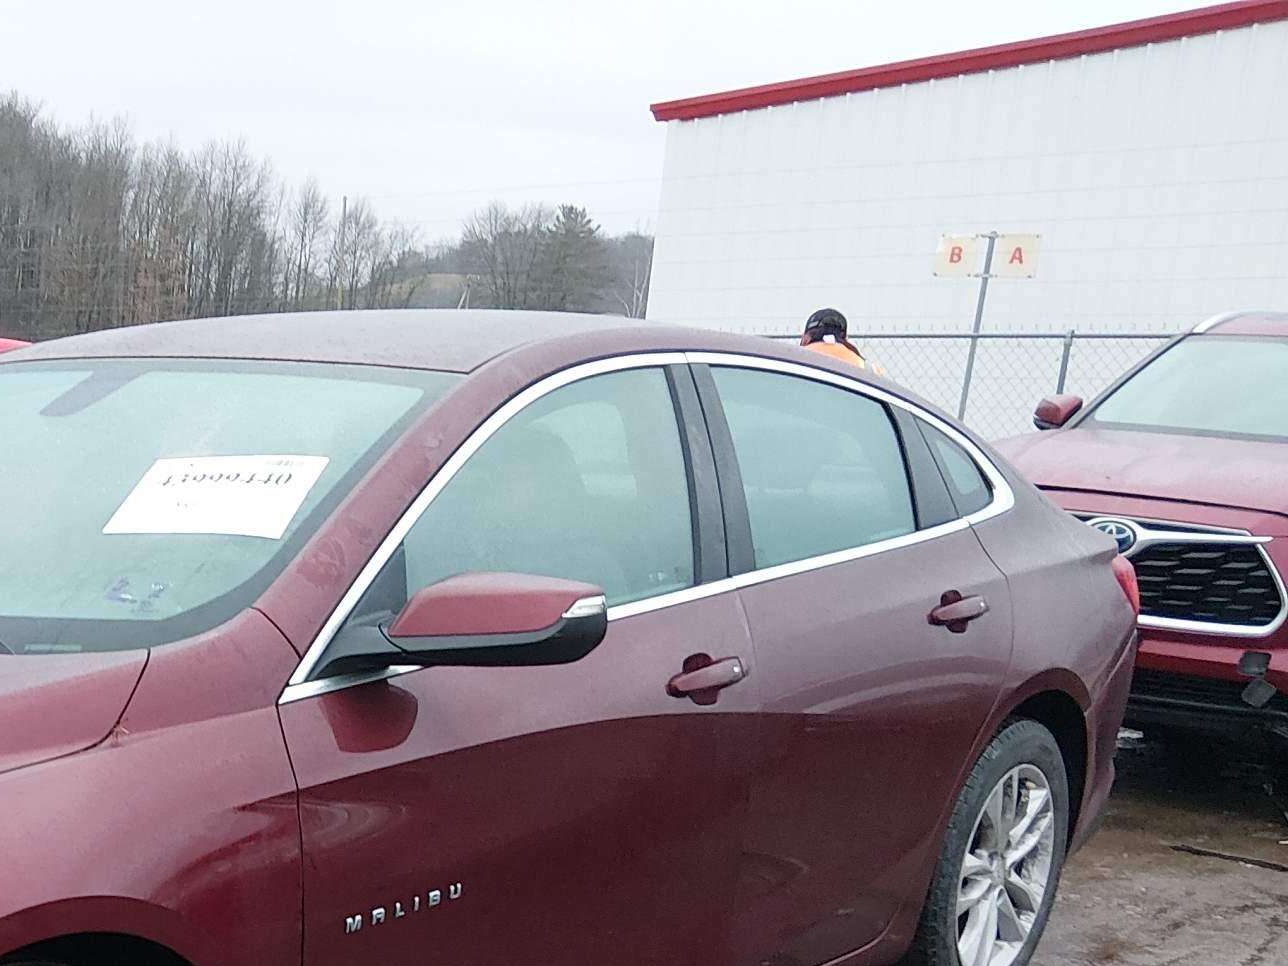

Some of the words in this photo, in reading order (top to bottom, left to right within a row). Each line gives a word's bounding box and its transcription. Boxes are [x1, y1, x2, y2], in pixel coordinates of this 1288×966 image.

[949, 246, 963, 264] B
[1009, 246, 1024, 265] A
[345, 882, 463, 934] MALIBU
